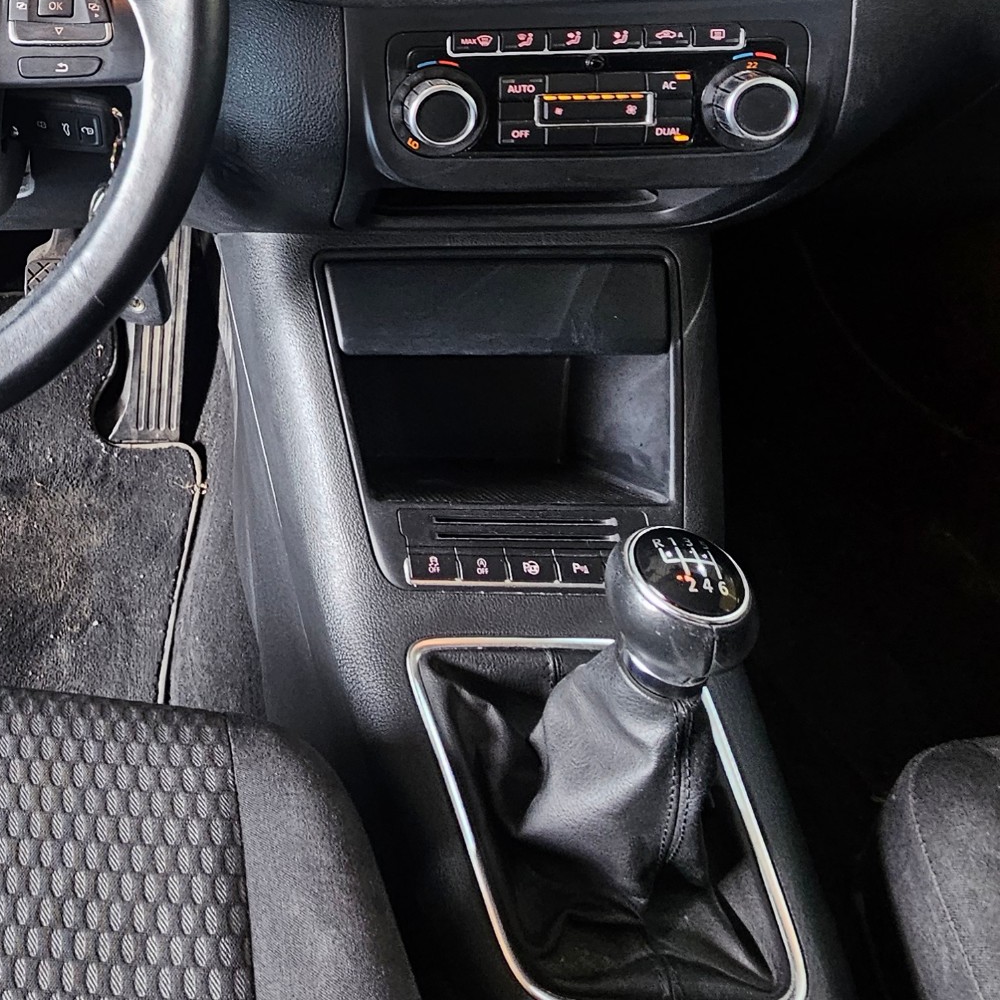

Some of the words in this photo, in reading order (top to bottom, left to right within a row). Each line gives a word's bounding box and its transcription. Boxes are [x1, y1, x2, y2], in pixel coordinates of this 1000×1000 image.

[48, 1, 63, 11] OK
[507, 84, 535, 94] AUTO
[662, 80, 677, 90] AC
[511, 129, 530, 139] OFF
[655, 126, 681, 136] DUAL
[652, 538, 664, 548] R
[667, 537, 677, 546] 1
[428, 565, 440, 574] OFF
[476, 567, 489, 575] OFF
[683, 575, 699, 593] 2
[702, 578, 714, 593] 4
[718, 581, 729, 596] 6
